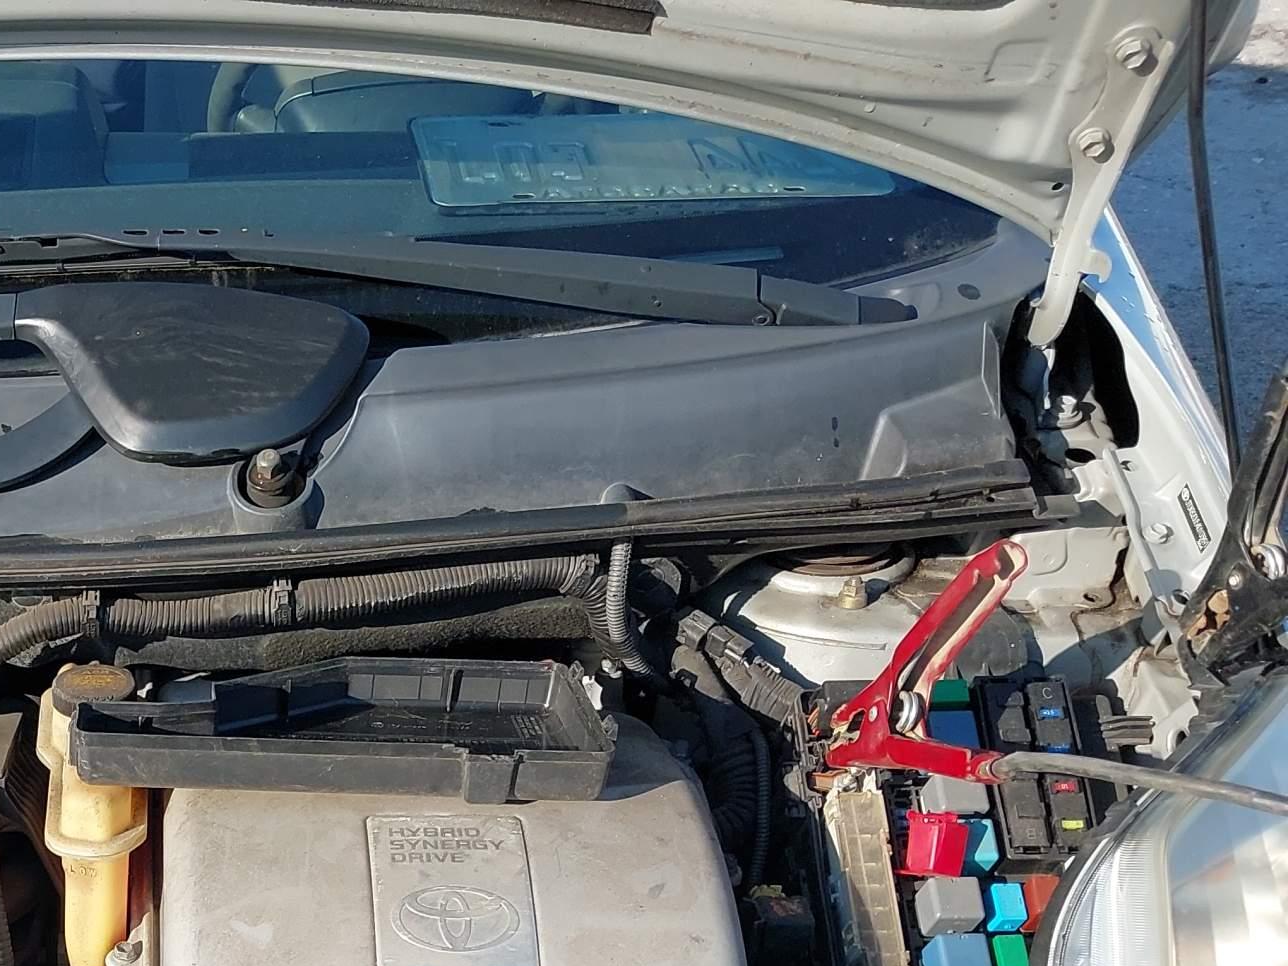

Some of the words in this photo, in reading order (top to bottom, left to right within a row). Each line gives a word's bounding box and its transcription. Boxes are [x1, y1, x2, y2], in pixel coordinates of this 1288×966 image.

[1042, 687, 1054, 699] C
[388, 827, 481, 838] HYBRID
[390, 839, 505, 851] SYNERGY
[391, 852, 466, 864] DRIVE
